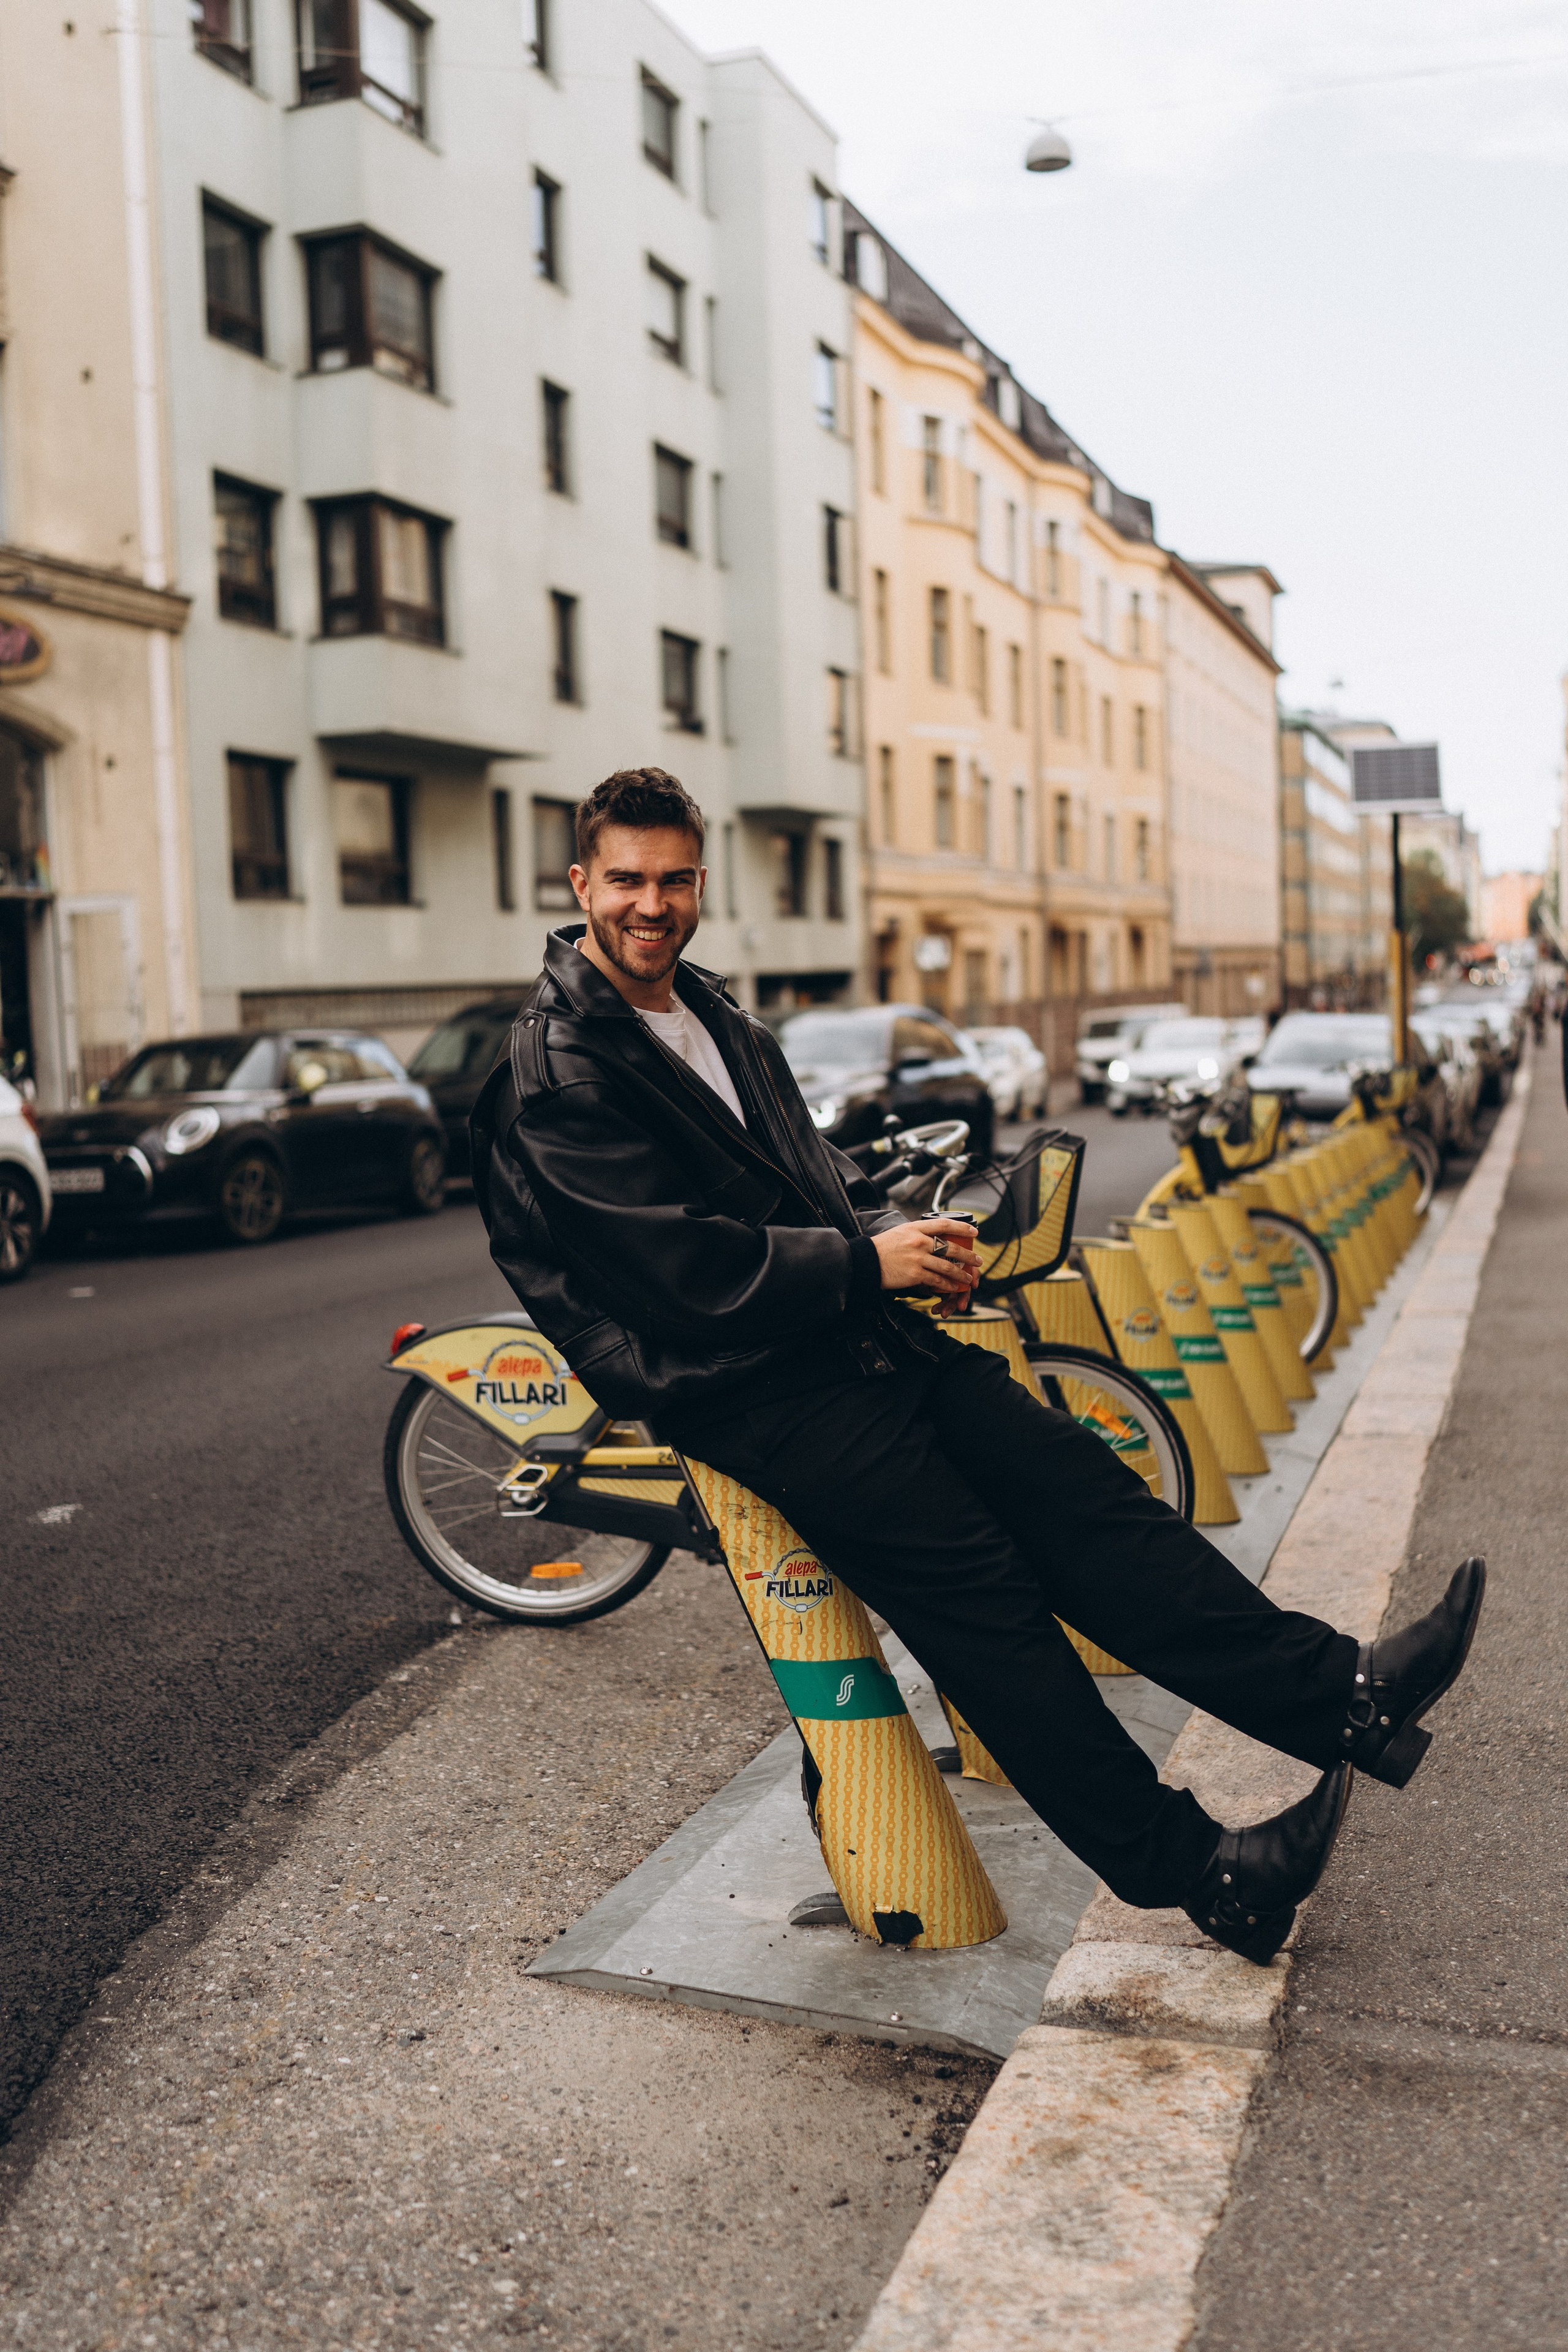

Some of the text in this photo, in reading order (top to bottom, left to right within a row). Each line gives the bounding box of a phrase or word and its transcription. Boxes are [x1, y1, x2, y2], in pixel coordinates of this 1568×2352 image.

[497, 1355, 542, 1376] alepa
[476, 1381, 567, 1406] FILLARI
[784, 1559, 818, 1577] alepa
[766, 1577, 834, 1598] FILLARI
